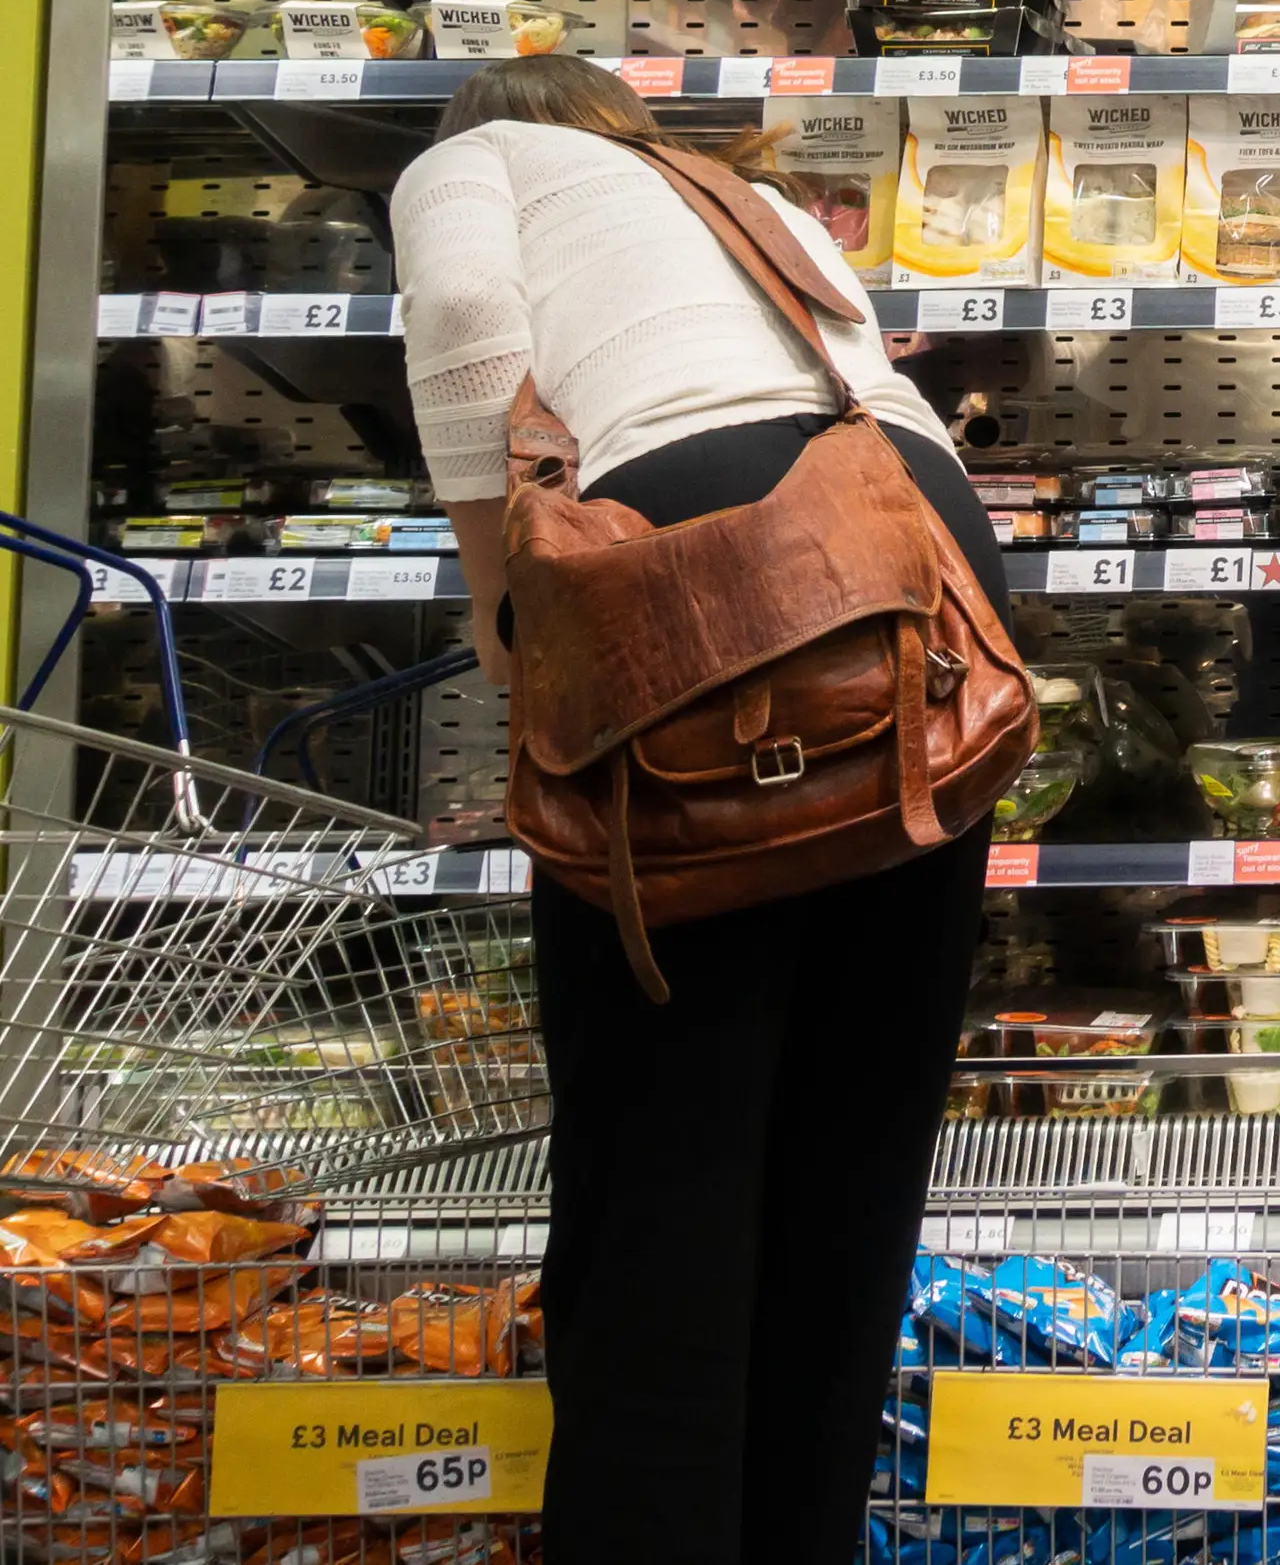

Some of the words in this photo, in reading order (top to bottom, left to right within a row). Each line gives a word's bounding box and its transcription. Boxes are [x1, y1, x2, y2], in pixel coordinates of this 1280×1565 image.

[288, 13, 351, 27] WICKED
[439, 8, 502, 25] WICKED
[320, 72, 359, 85] £3.50
[918, 70, 957, 82] £3.50
[803, 116, 865, 132] WICKED
[945, 108, 1008, 124] WICKED
[1088, 107, 1151, 122] WICKED
[305, 304, 341, 328] £2
[962, 298, 998, 321] £3
[1090, 297, 1126, 320] £3
[269, 567, 306, 591] £2
[393, 571, 432, 583] £3.50
[1093, 558, 1127, 585] £1
[1211, 556, 1245, 583] £1
[394, 861, 430, 885] £3
[1241, 864, 1256, 873] out
[291, 1425, 327, 1449] £3
[337, 1424, 404, 1448] Meal
[415, 1422, 479, 1447] Deal
[1008, 1417, 1041, 1440] £3
[1053, 1418, 1118, 1442] Meal
[1129, 1420, 1191, 1444] Deal
[416, 1455, 487, 1491] 65p
[1142, 1466, 1212, 1496] 60p
